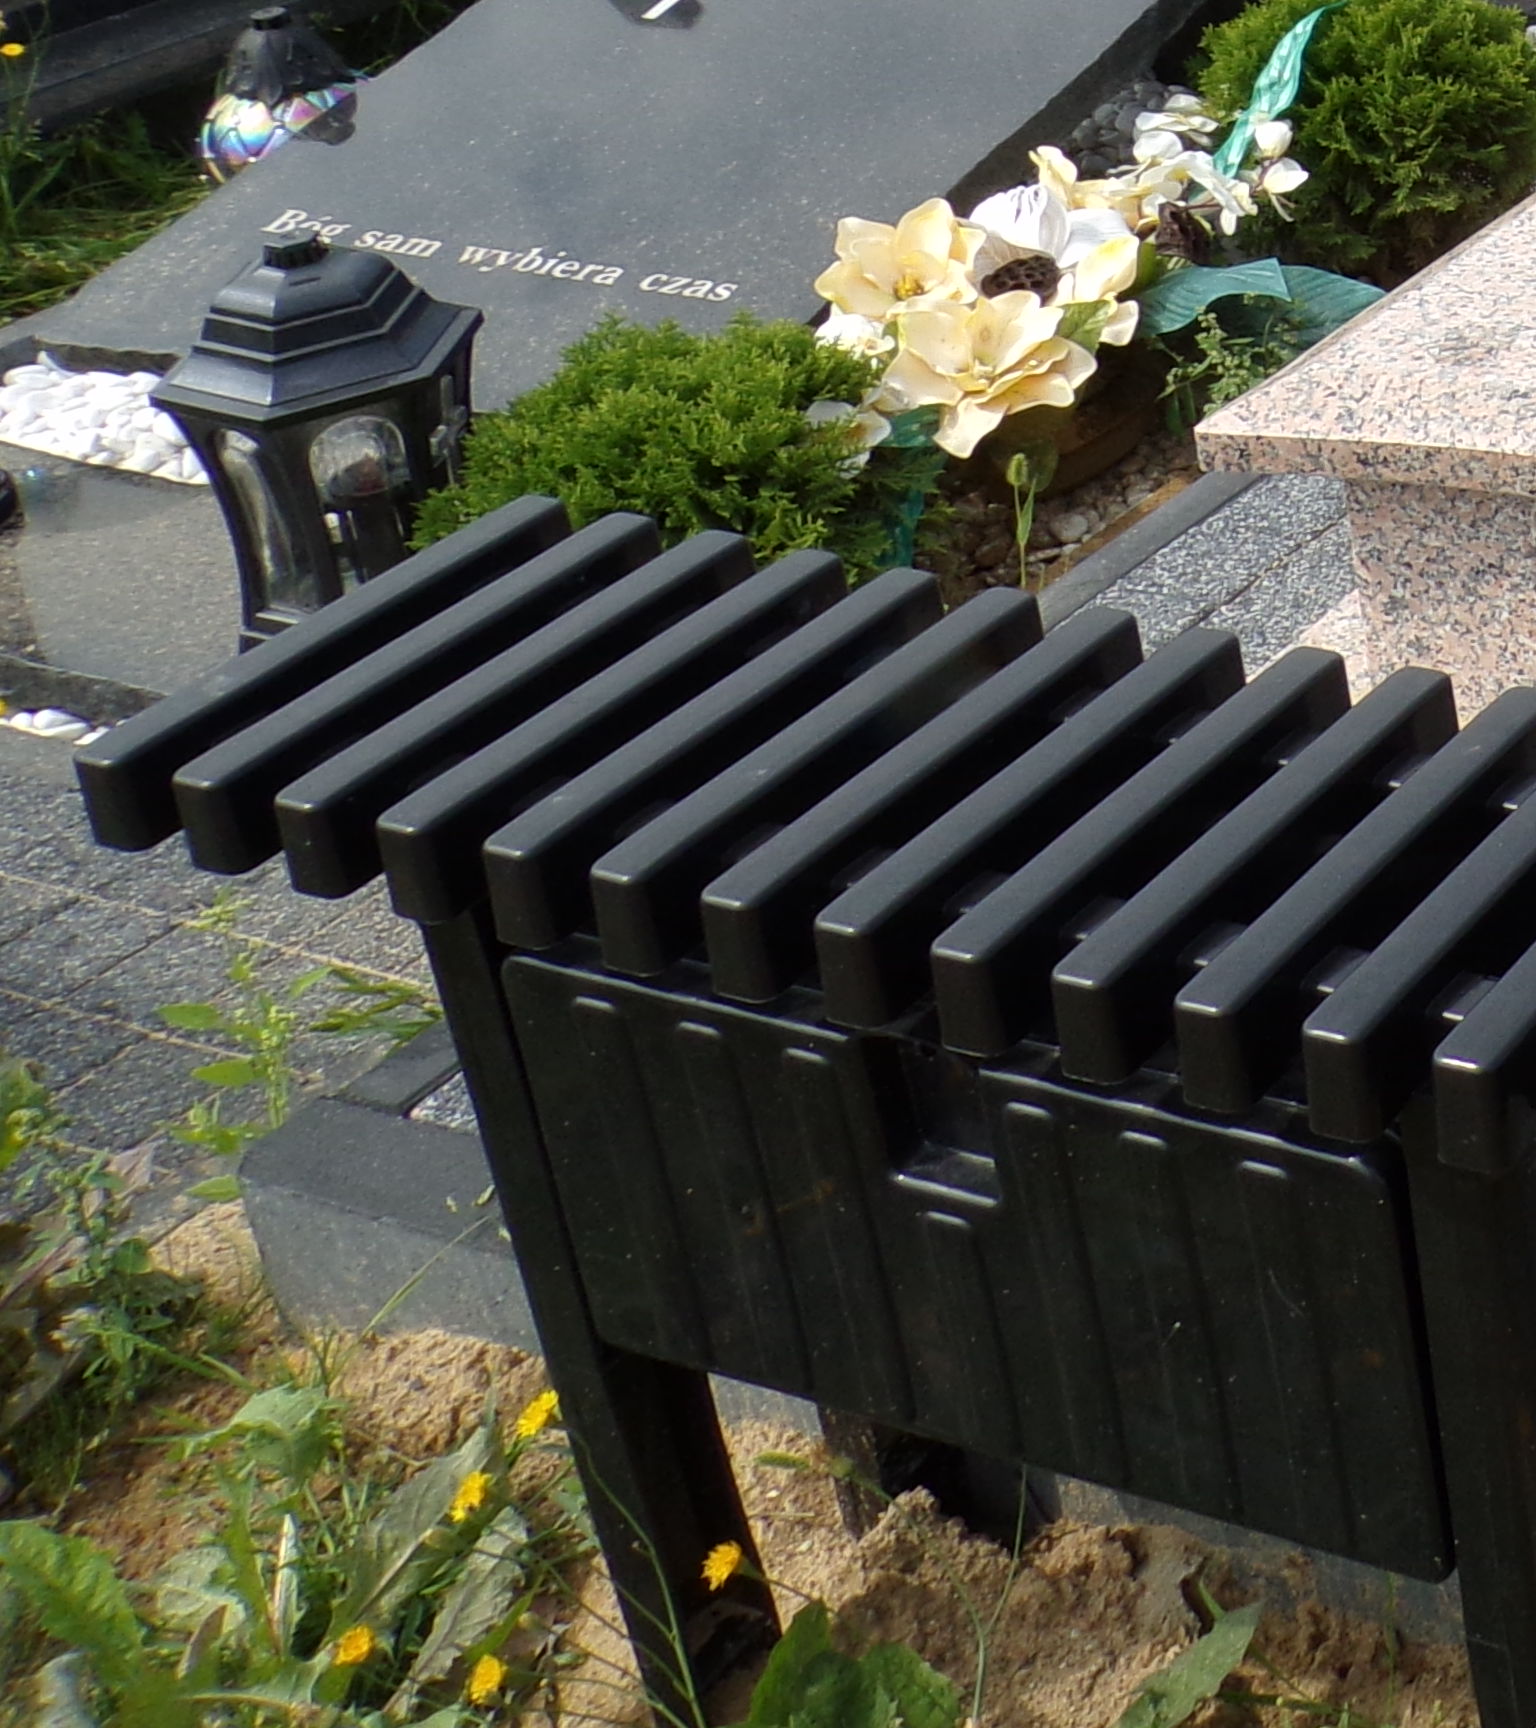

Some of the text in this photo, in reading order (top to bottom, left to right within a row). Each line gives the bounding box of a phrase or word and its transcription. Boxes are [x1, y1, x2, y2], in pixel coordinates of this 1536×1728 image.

[260, 208, 740, 303] Bóg sam wybiera czas
